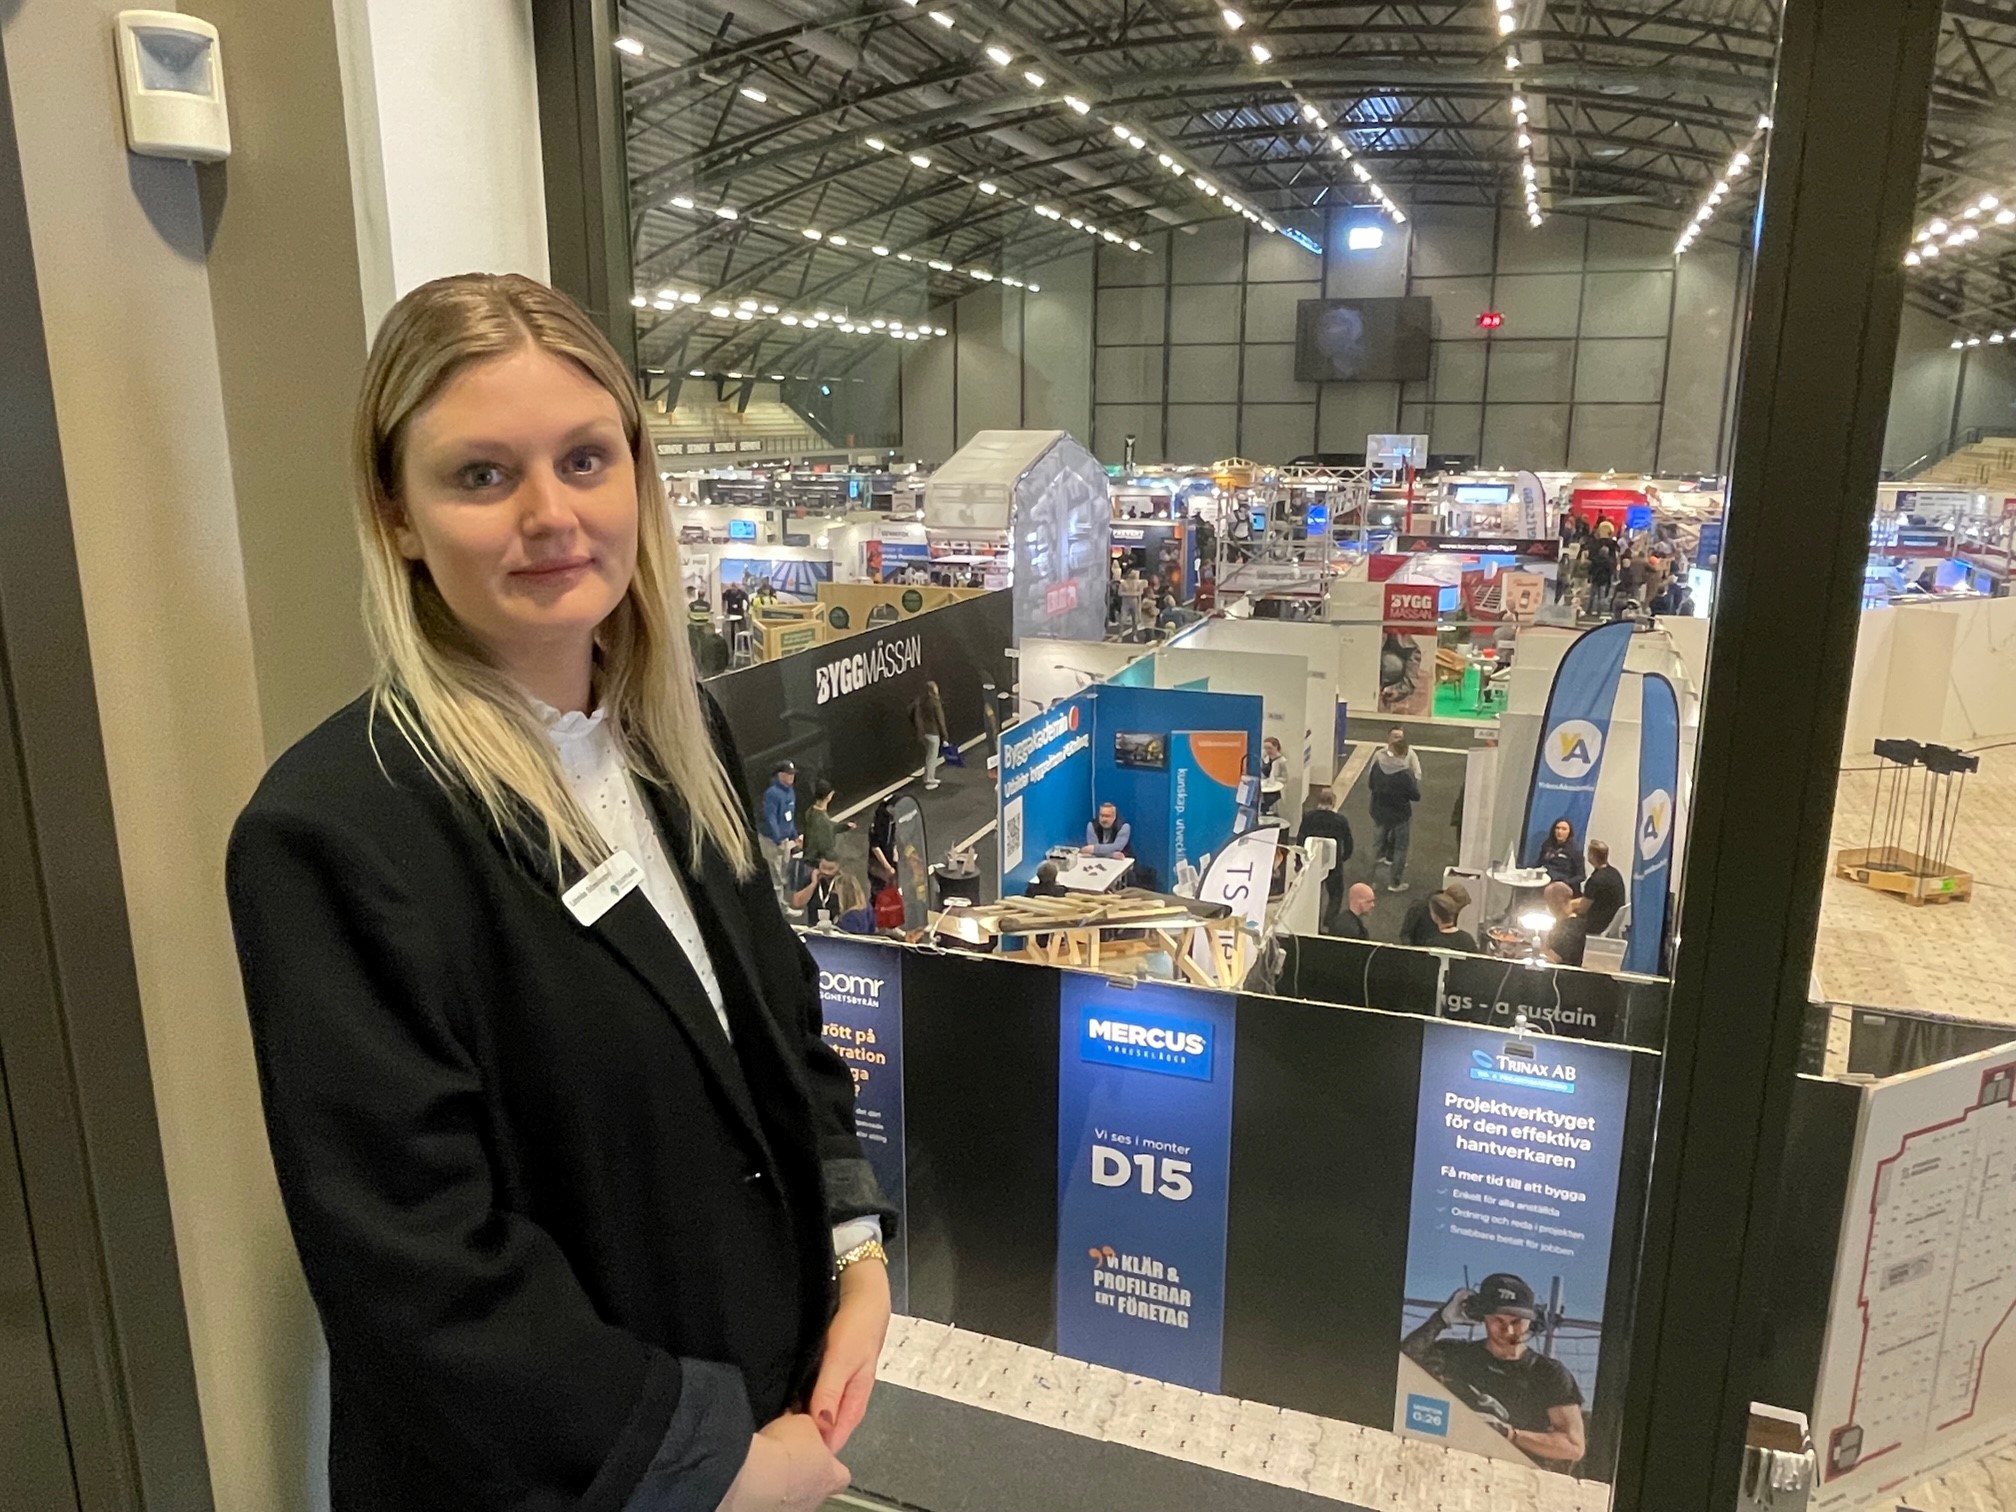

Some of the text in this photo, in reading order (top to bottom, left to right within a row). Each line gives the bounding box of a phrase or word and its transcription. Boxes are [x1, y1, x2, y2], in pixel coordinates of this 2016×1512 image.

[816, 634, 921, 705] BYGGMÄSSAN
[819, 970, 884, 998] oomr
[1496, 1001, 1510, 1015] a
[822, 1023, 876, 1045] rött på
[1089, 1018, 1205, 1055] MERCUS
[832, 1044, 886, 1065] tration
[850, 1067, 870, 1082] ga
[1552, 1064, 1577, 1081] AB
[1445, 1092, 1596, 1131] Projektverktyget
[1094, 1128, 1108, 1140] Vi
[1111, 1133, 1132, 1145] ses
[1142, 1139, 1191, 1155] monter
[1445, 1113, 1591, 1151] för den effektiva
[1456, 1135, 1576, 1169] hantverkaren
[1091, 1144, 1193, 1201] D15
[1440, 1166, 1586, 1202] Få mer tid till att bygga
[1491, 1215, 1509, 1225] och
[1121, 1254, 1164, 1279] KLÄR
[1167, 1267, 1179, 1283] &
[1093, 1269, 1191, 1307] PROFILERAR
[1095, 1291, 1188, 1329] ERT FÖRETAG
